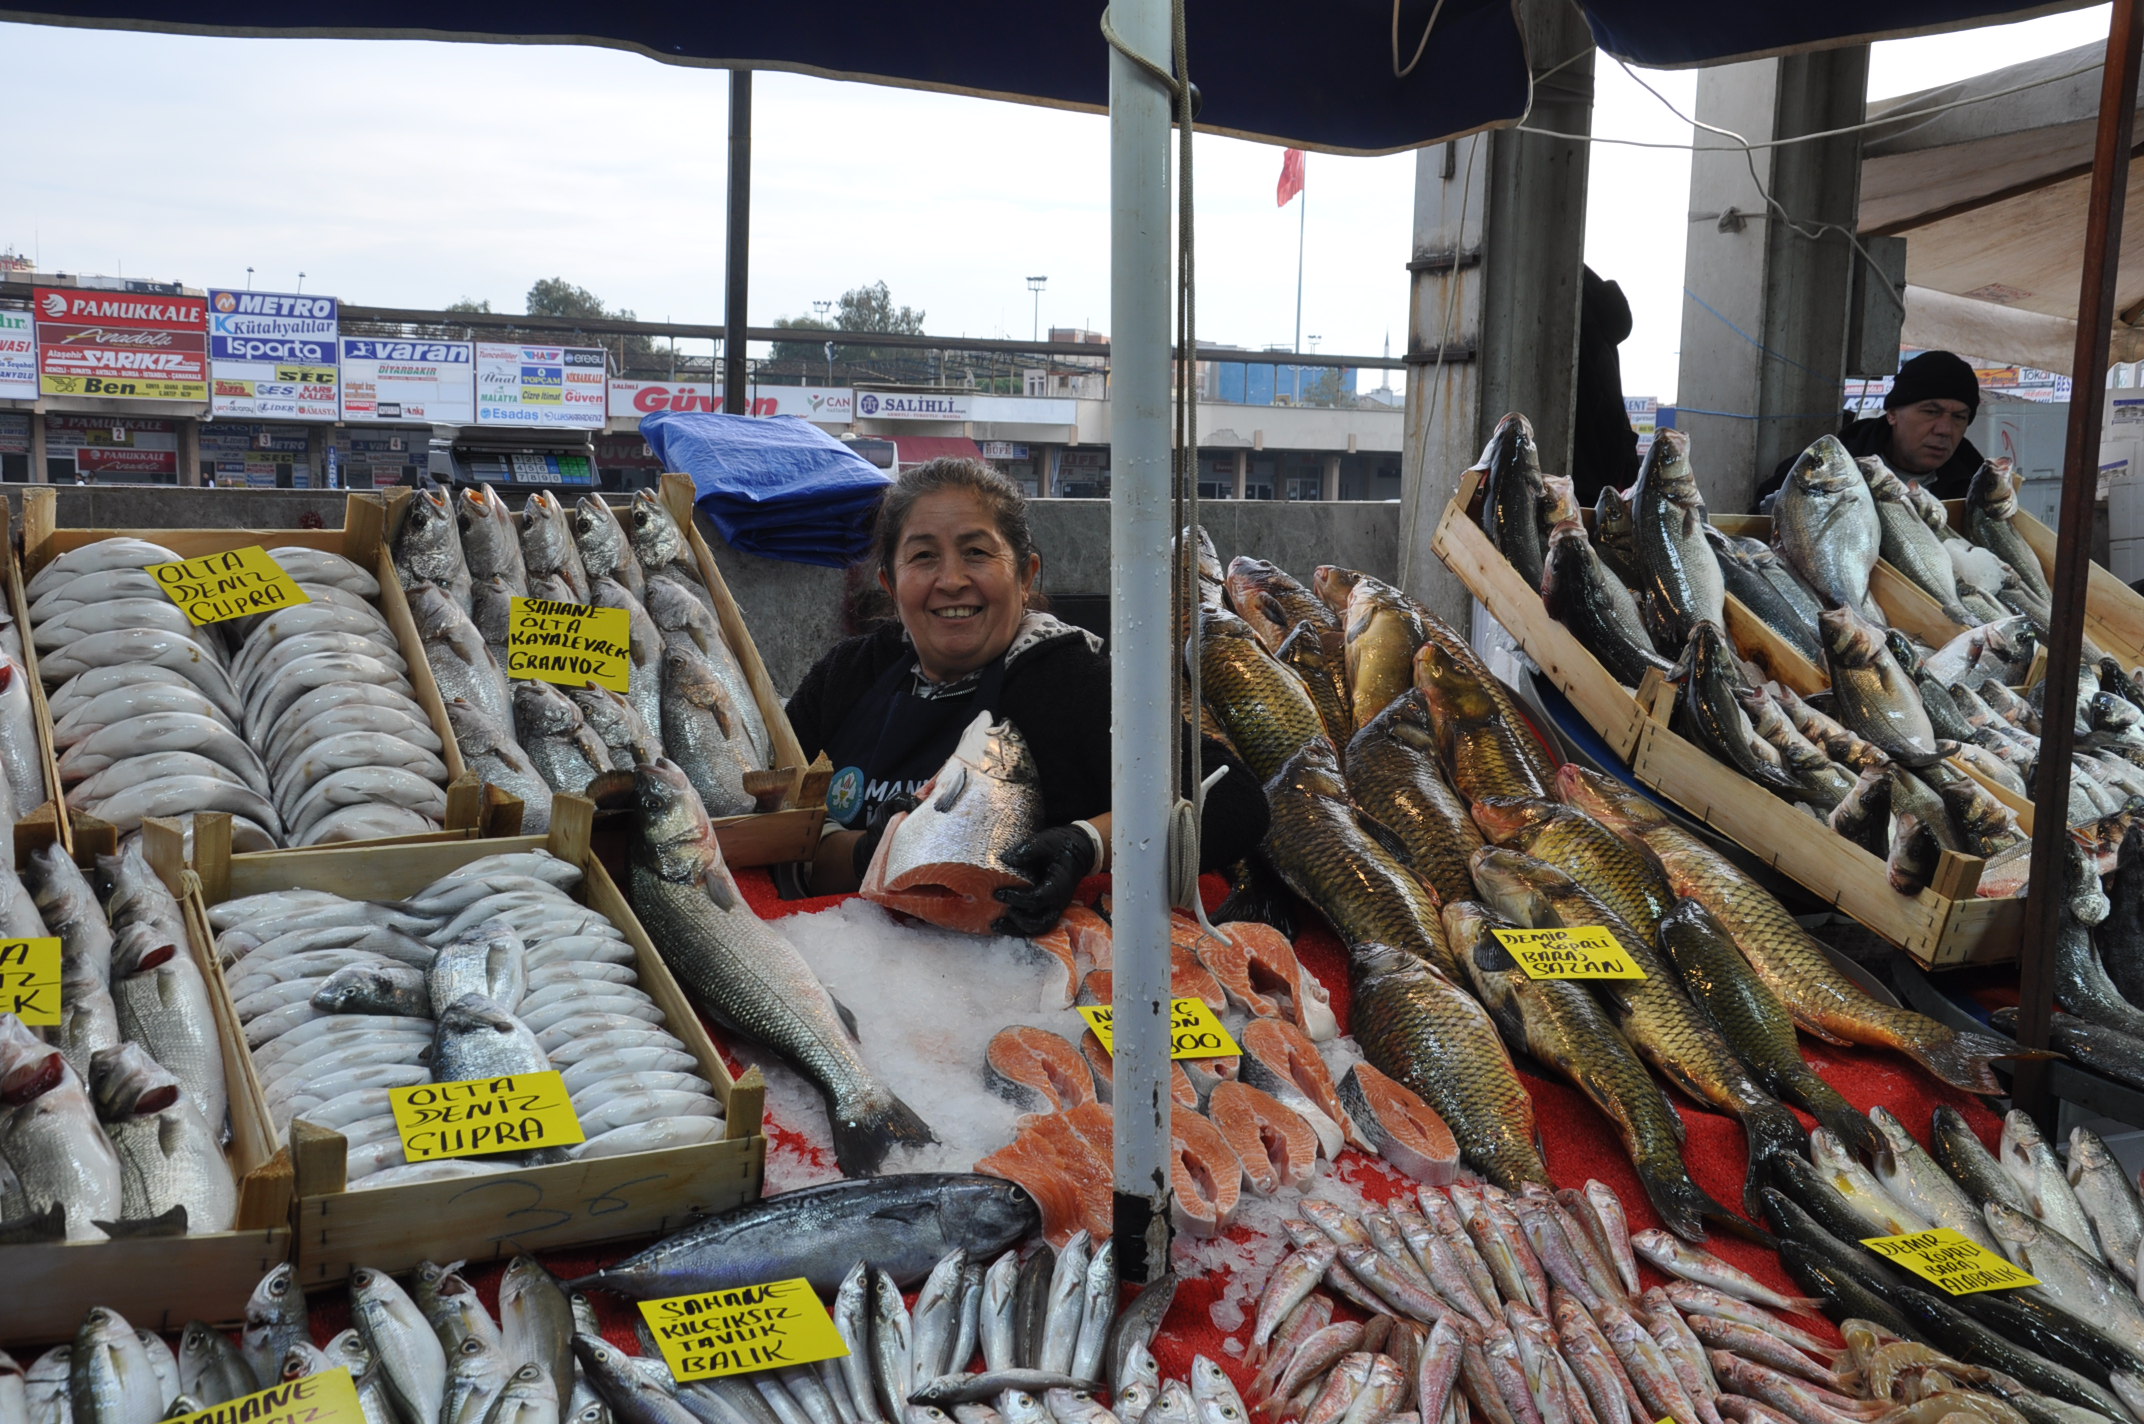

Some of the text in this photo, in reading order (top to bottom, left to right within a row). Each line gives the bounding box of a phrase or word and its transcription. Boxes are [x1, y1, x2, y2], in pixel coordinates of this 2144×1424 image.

[0, 260, 27, 270] TEL
[72, 299, 200, 323] PAMUKKALE
[238, 294, 331, 318] METRO
[61, 328, 173, 346] Anadolu
[234, 319, 334, 338] Kütahyalılar
[226, 336, 322, 360] Isparta
[375, 342, 469, 362] varan
[83, 350, 184, 371] SARIKIZ
[84, 377, 136, 395] Ben
[565, 391, 603, 403] Güven
[633, 386, 779, 416] Güvn
[826, 397, 850, 407] CAN
[885, 396, 955, 413] SALİHLİ
[116, 429, 122, 440] 2
[262, 434, 269, 445] 3
[103, 451, 165, 461] PAMUKKALE
[368, 442, 406, 451] varn
[157, 551, 244, 584] OLTA
[173, 571, 281, 603] DENİZ
[511, 630, 630, 660] KAYALEVREK
[1532, 959, 1625, 977] SAZAN
[407, 1077, 516, 1106] OLTA
[405, 1095, 561, 1128] DENİZ
[406, 1117, 544, 1156] ÇUPRA
[1939, 1265, 2031, 1293] ALABALIK
[678, 1323, 788, 1352] TAVUK
[681, 1339, 796, 1373] BALIK
[163, 1376, 318, 1424] HANE
